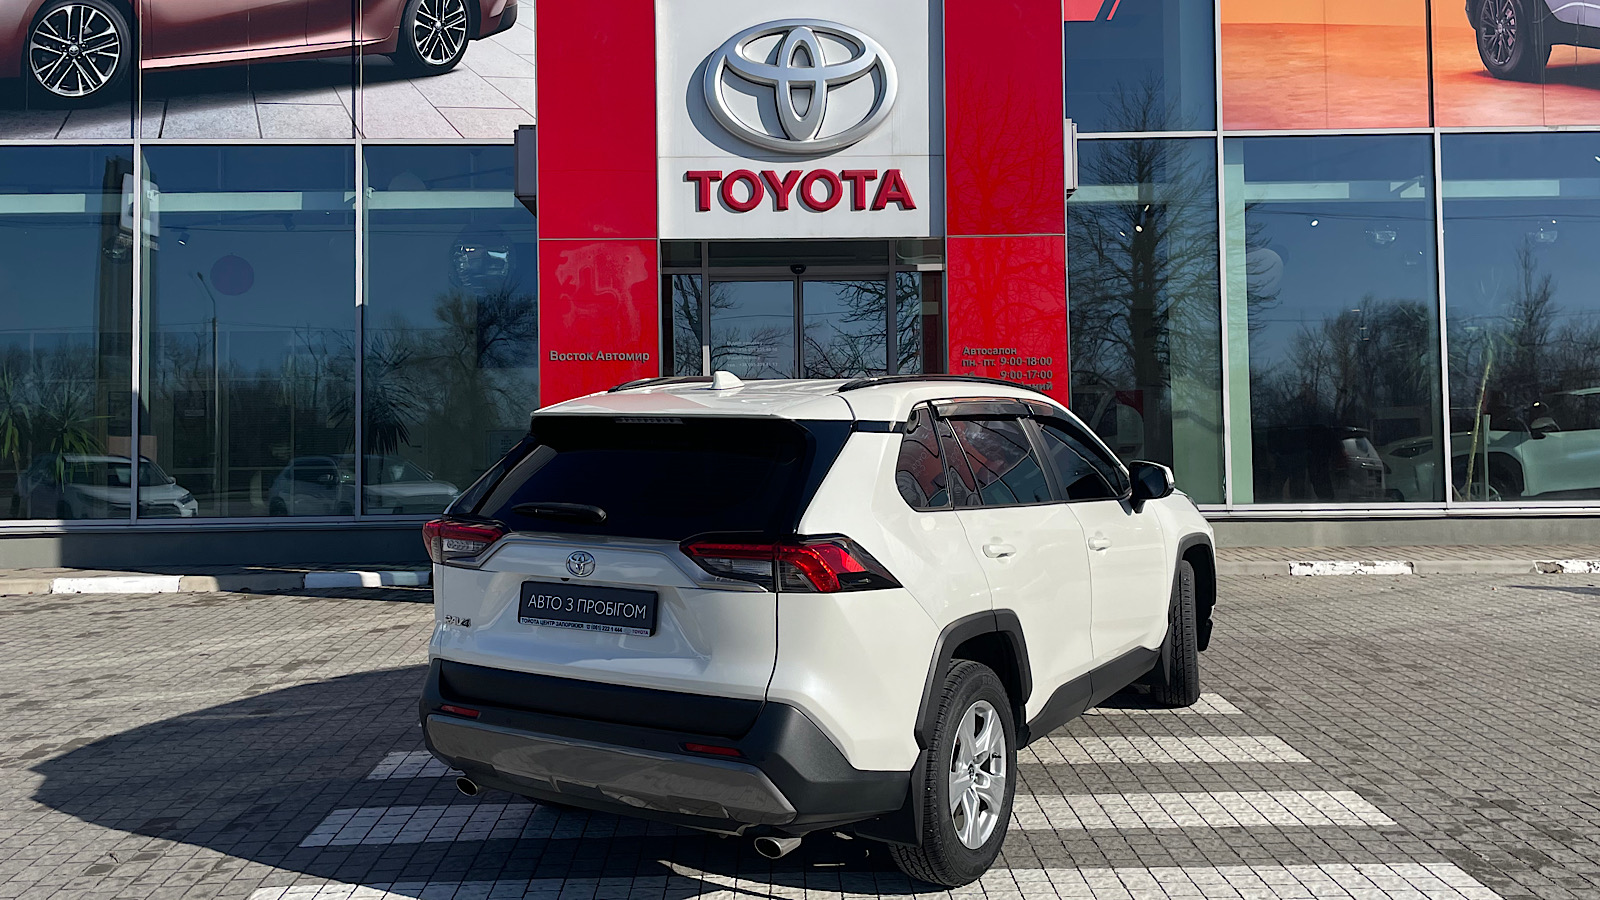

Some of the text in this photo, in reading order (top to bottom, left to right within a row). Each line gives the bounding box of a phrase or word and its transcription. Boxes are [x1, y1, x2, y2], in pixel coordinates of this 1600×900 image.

[686, 169, 917, 212] TOYOTA
[963, 346, 1017, 355] Автосалон
[550, 350, 650, 363] Восток Автомир
[1000, 357, 1053, 366] 9:00-18:00
[1000, 371, 1053, 379] 9:00-17:00
[527, 594, 562, 610] АВТО
[577, 599, 647, 619] ПРОБІГОМ
[521, 617, 539, 625] ТОЙОТА
